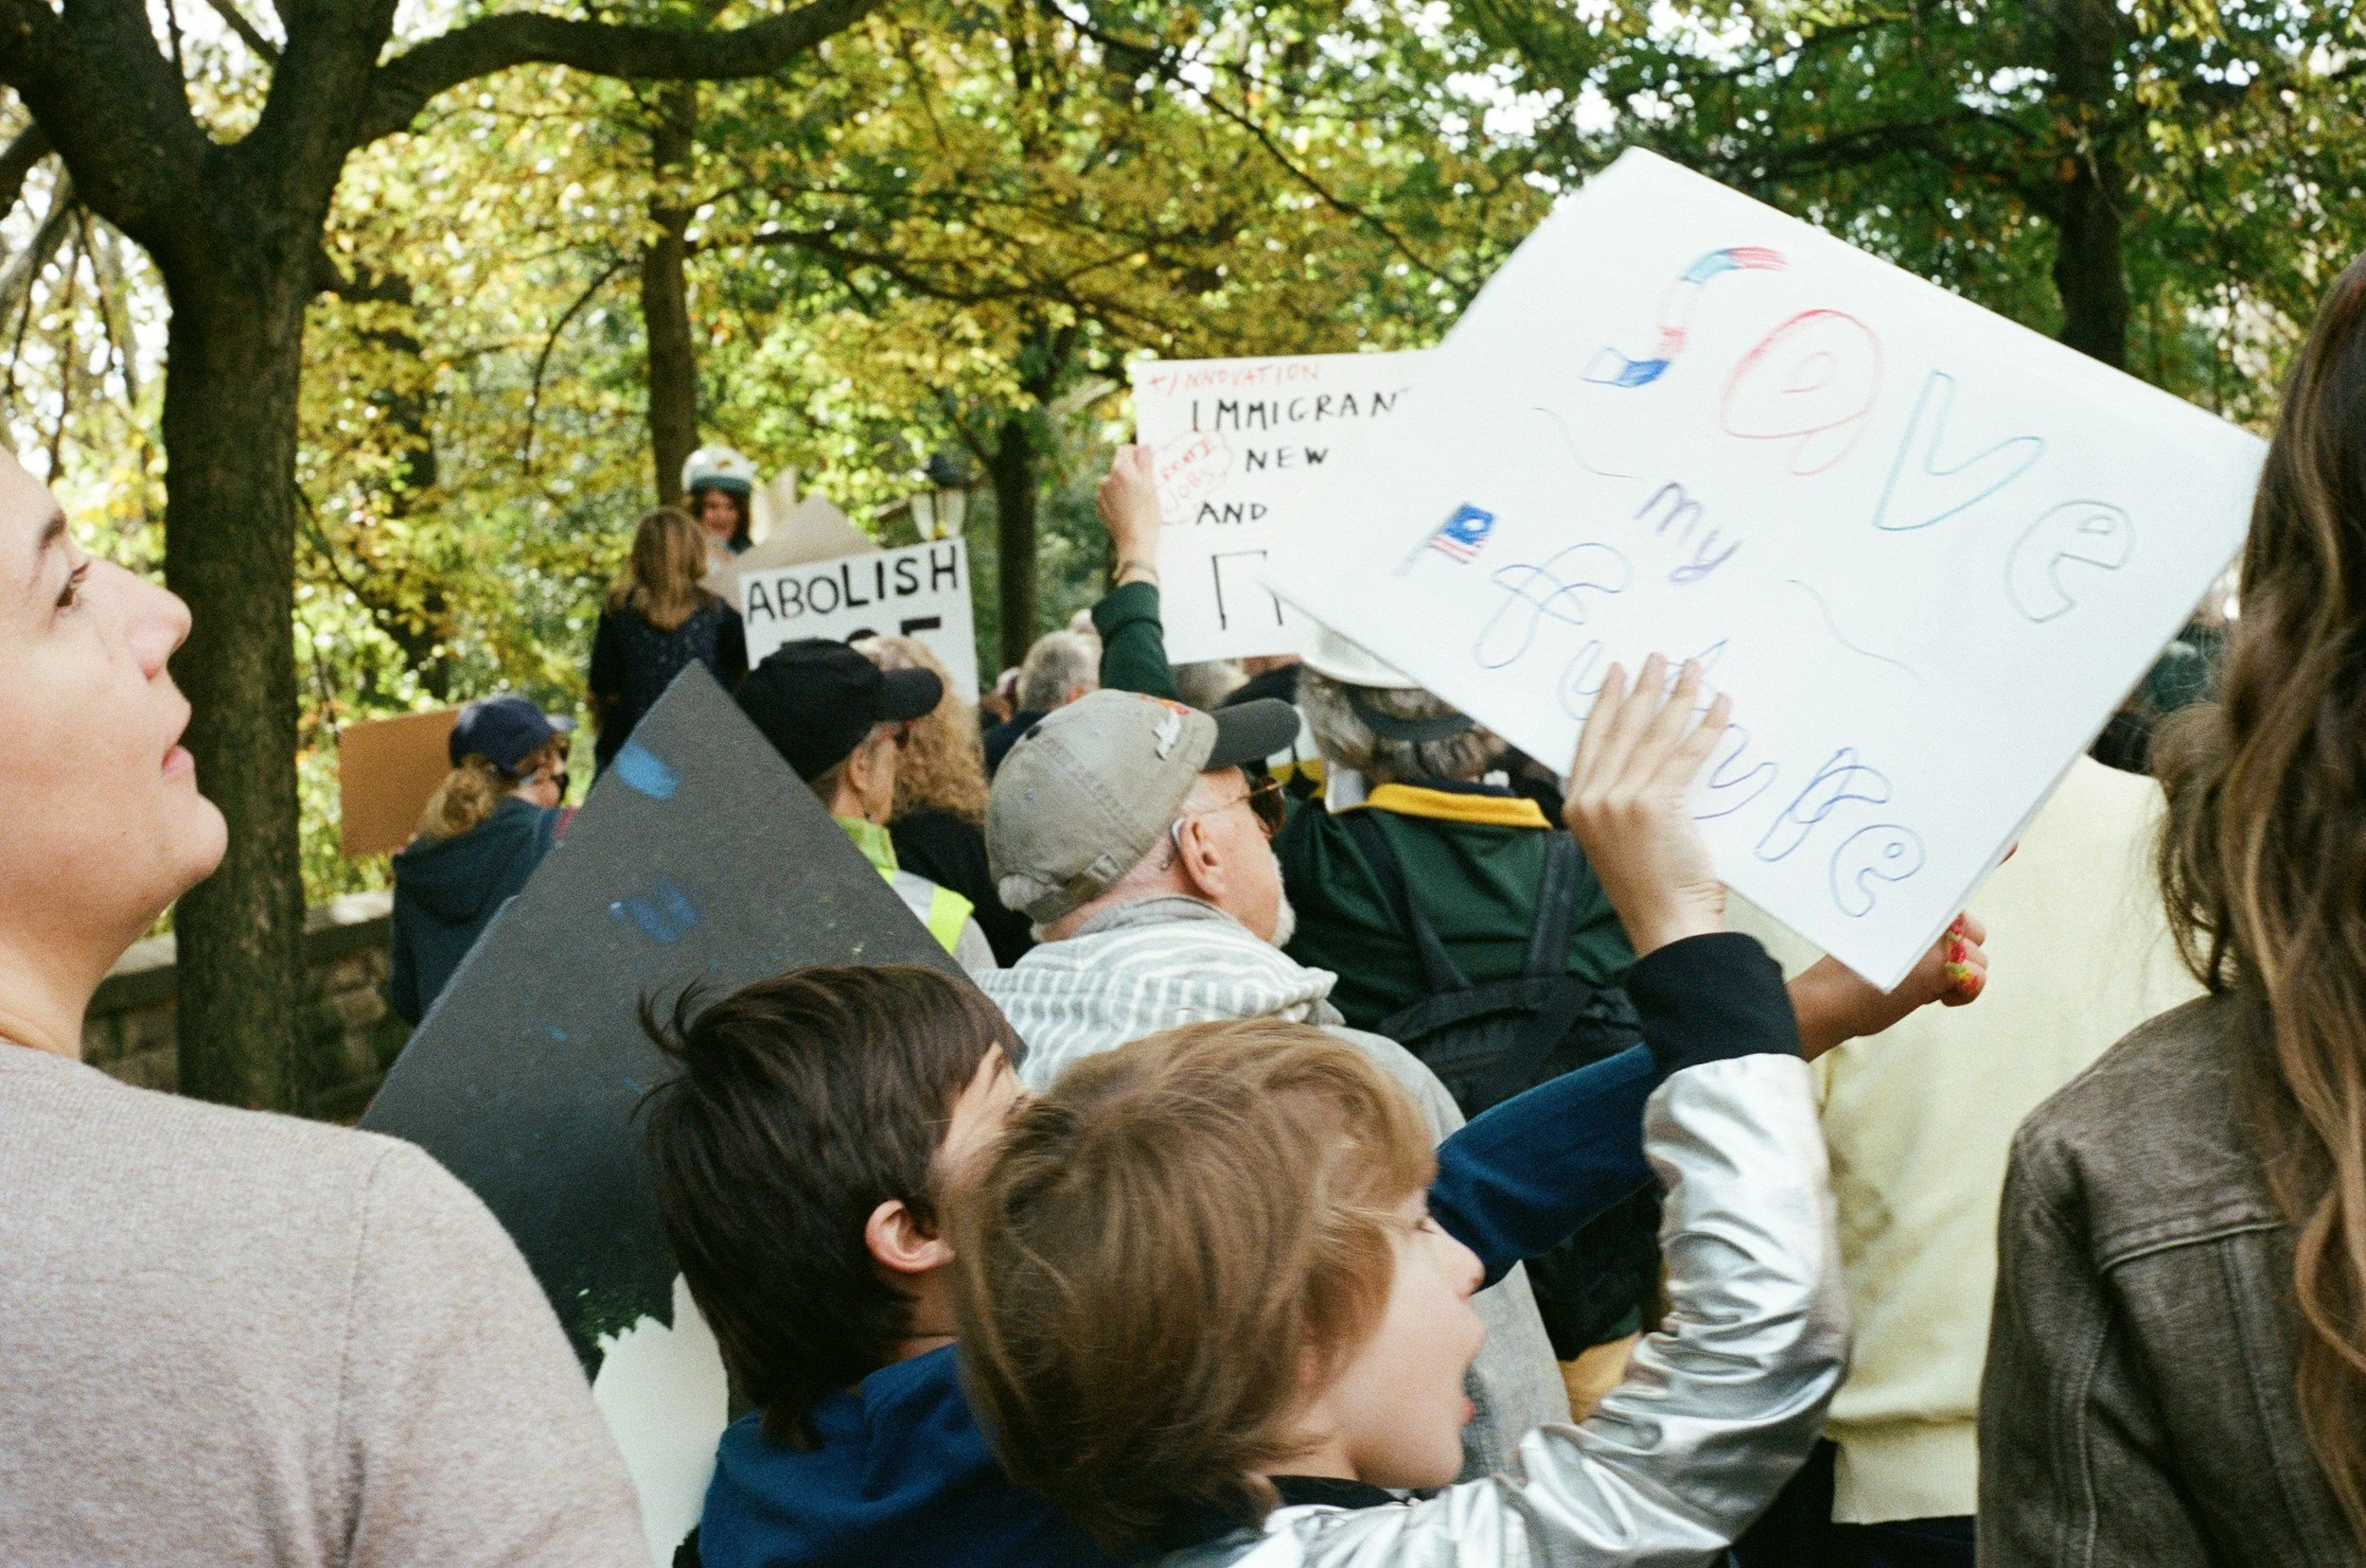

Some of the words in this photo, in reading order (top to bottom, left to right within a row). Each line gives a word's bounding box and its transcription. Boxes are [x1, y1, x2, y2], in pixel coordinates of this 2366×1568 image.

[1192, 386, 1411, 432] IMMIGRAN
[1245, 447, 1329, 473] NEW
[1195, 502, 1269, 525] AND
[747, 542, 958, 625] ABOLISH
